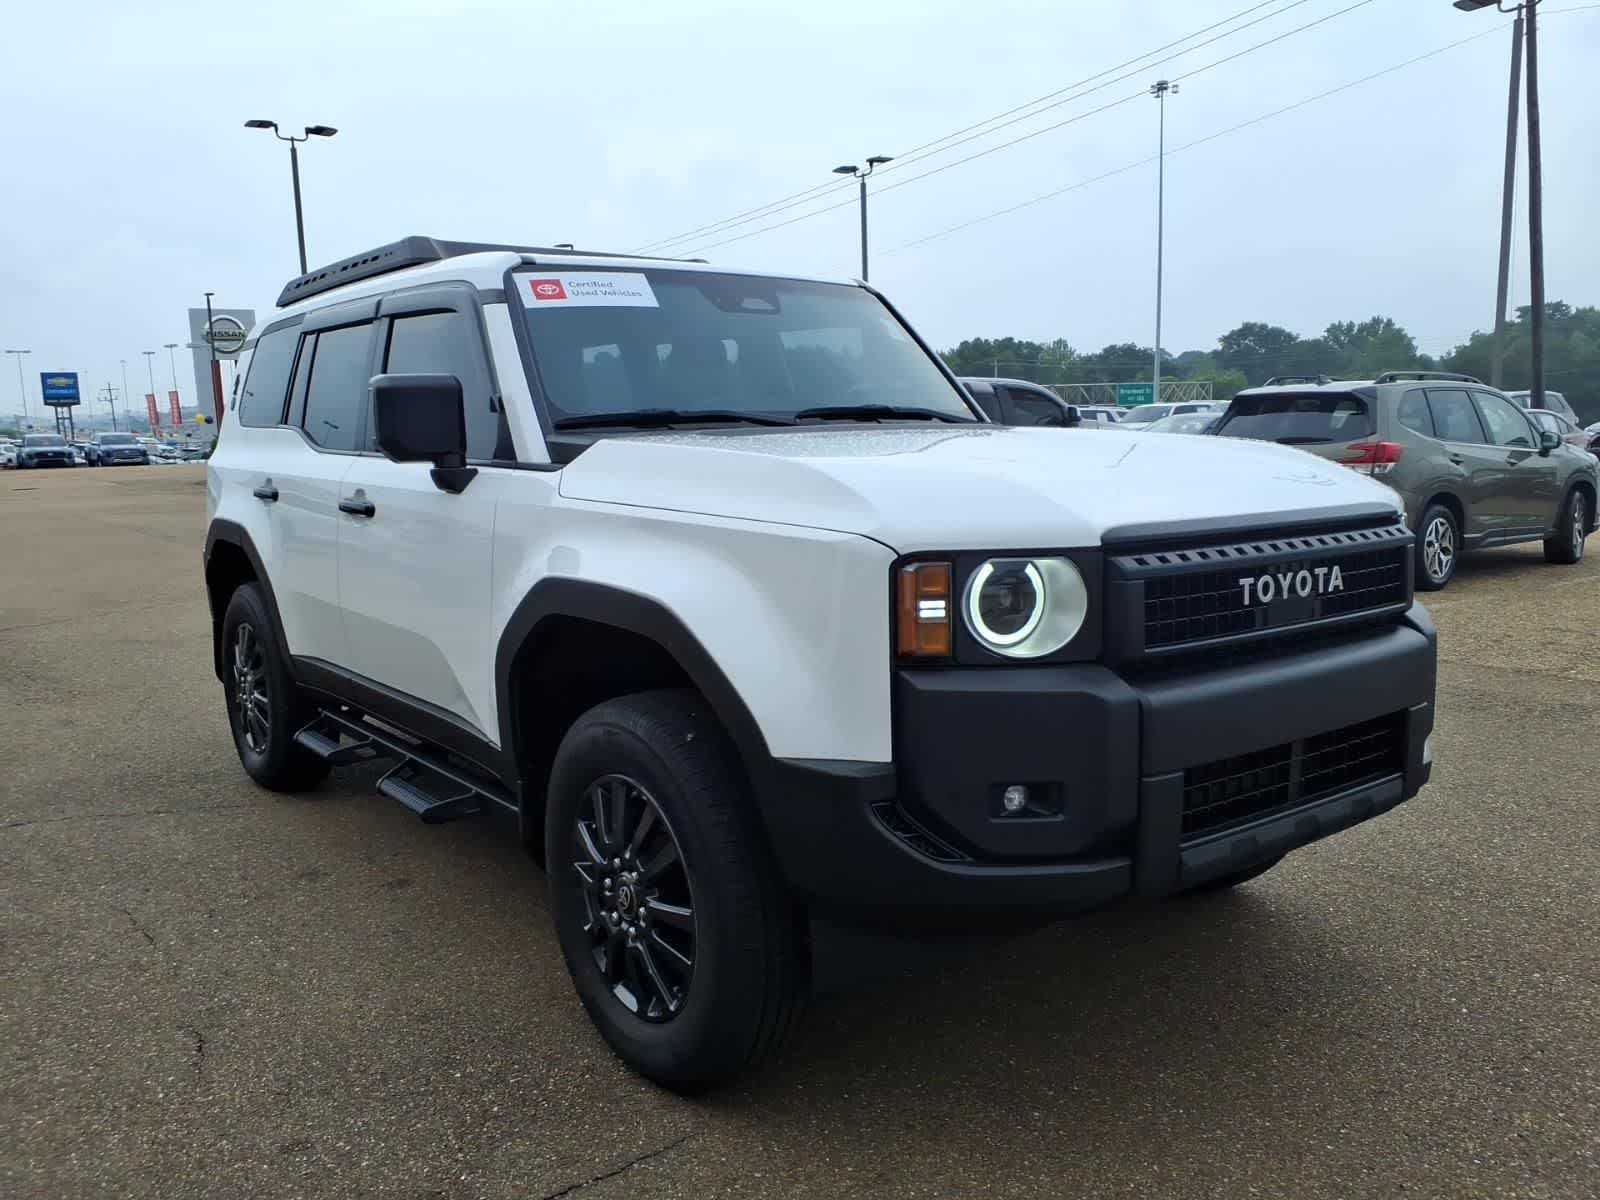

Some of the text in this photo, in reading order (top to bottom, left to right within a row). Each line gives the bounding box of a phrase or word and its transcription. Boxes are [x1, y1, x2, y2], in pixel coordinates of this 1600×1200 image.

[568, 280, 615, 288] Certified
[571, 289, 643, 298] Used Vehicles
[1239, 565, 1344, 606] TOYOTA
